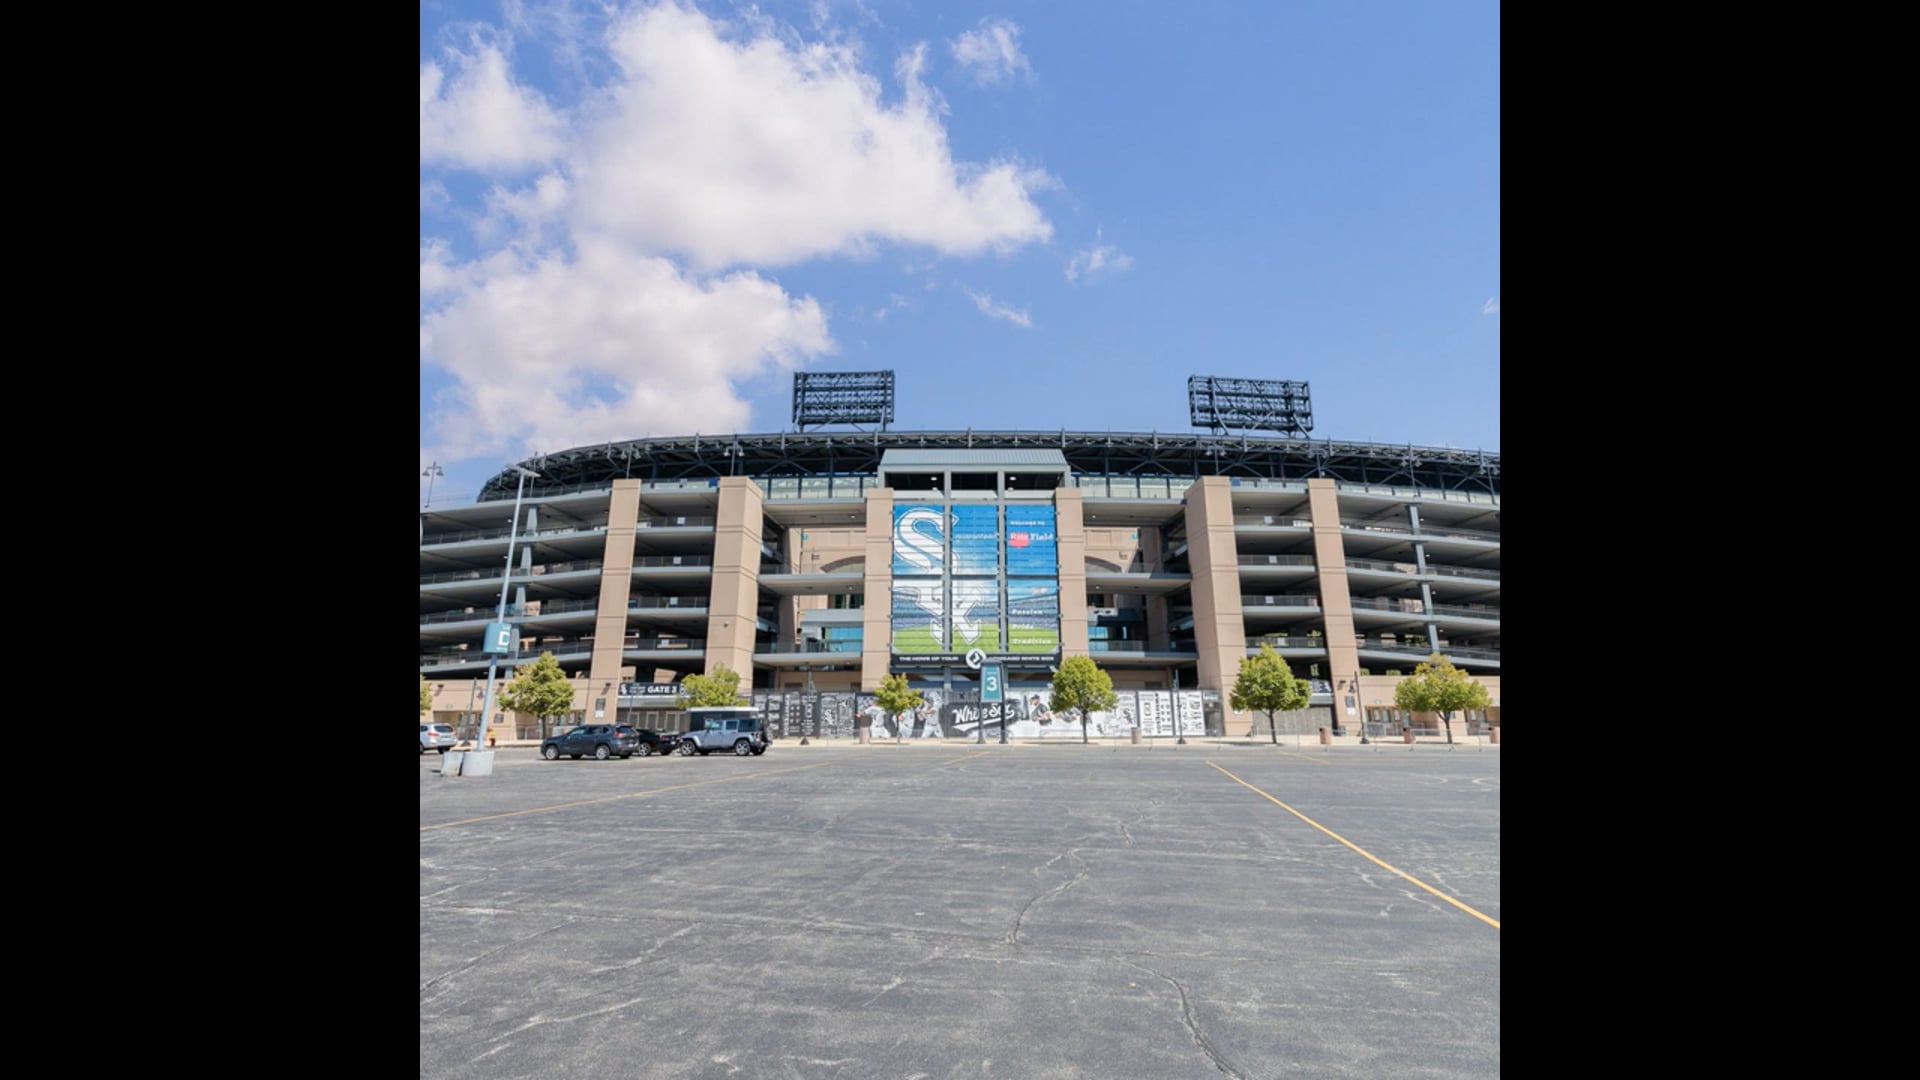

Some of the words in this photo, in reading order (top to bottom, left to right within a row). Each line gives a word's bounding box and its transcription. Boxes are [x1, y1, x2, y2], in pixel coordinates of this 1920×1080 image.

[1030, 532, 1054, 541] Field
[647, 685, 670, 694] GATE
[671, 685, 678, 694] 3
[986, 676, 998, 691] 3
[952, 705, 988, 723] Whie
